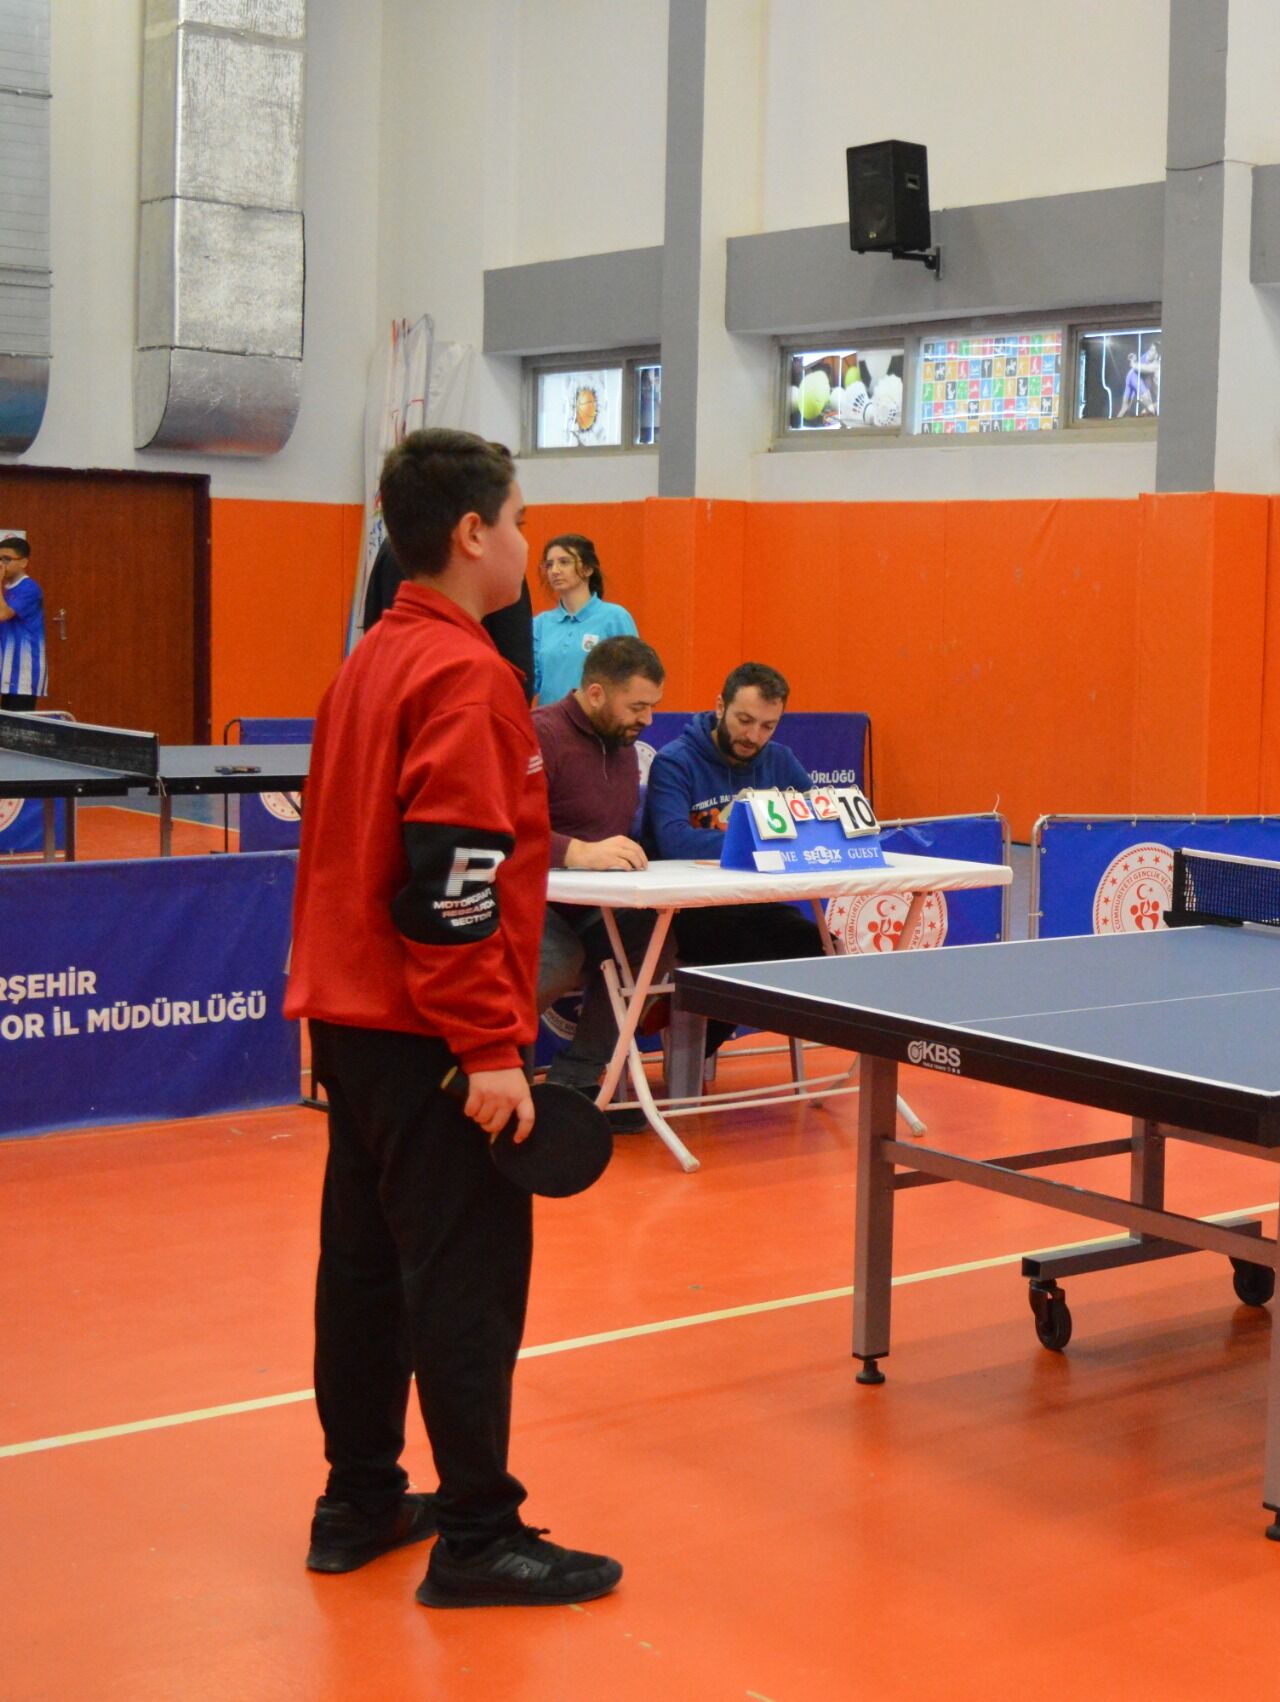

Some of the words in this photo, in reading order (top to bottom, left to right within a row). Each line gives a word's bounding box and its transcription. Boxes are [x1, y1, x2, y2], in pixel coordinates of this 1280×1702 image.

[808, 769, 855, 784] ÜRLÜĞÜ
[767, 799, 788, 834] 6
[789, 799, 810, 819] 0
[815, 795, 838, 817] 2
[838, 796, 876, 830] 10
[780, 851, 798, 863] ME
[848, 847, 879, 859] GUEST
[53, 1006, 80, 1037] İL
[87, 990, 267, 1033] MÜDÜRLÜĞÜ
[922, 1041, 961, 1067] KBS
